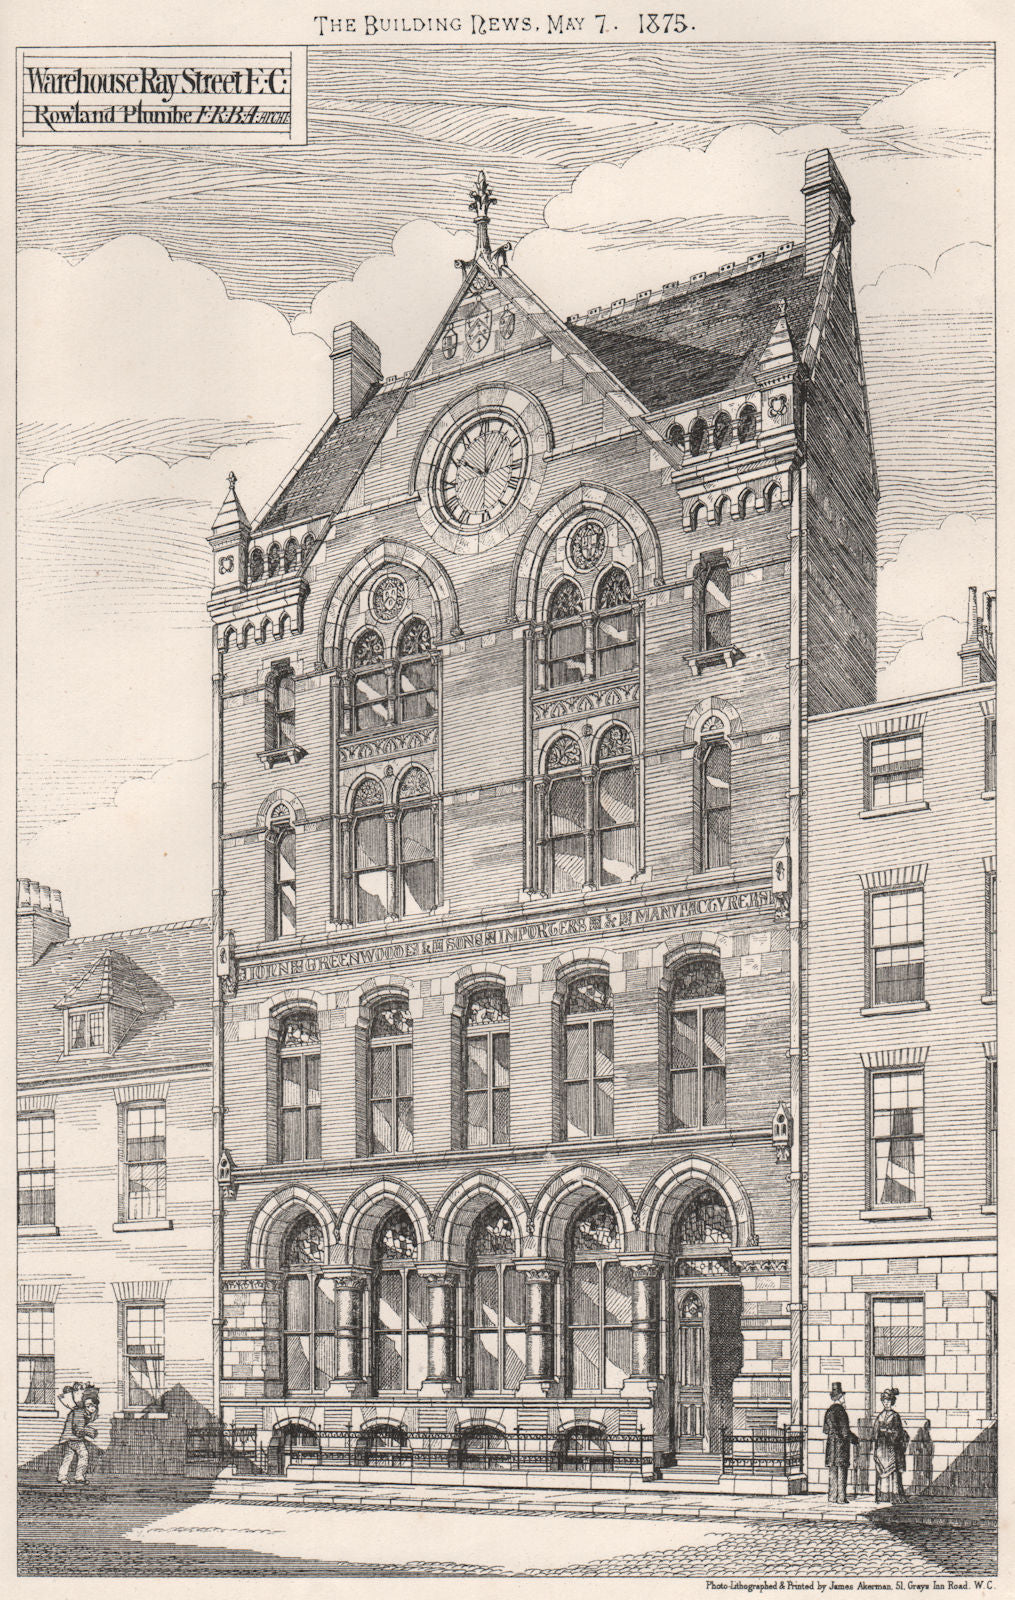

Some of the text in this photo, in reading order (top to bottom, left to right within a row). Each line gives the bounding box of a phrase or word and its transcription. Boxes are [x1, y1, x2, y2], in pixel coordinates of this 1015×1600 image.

[313, 15, 357, 36] THE
[364, 14, 463, 36] BUILDING
[547, 14, 585, 35] MAY
[639, 13, 697, 34] 1875.
[26, 66, 139, 94] Warehouse
[139, 66, 179, 103] Ray
[181, 67, 243, 95] Street
[33, 99, 115, 132] Rowland
[119, 98, 193, 125] Plumbe
[779, 1581, 786, 1590] &
[787, 1581, 814, 1590] Printed
[817, 1581, 827, 1593] by
[829, 1581, 854, 1590] James
[907, 1581, 930, 1592] Grays
[933, 1581, 945, 1590] Inn
